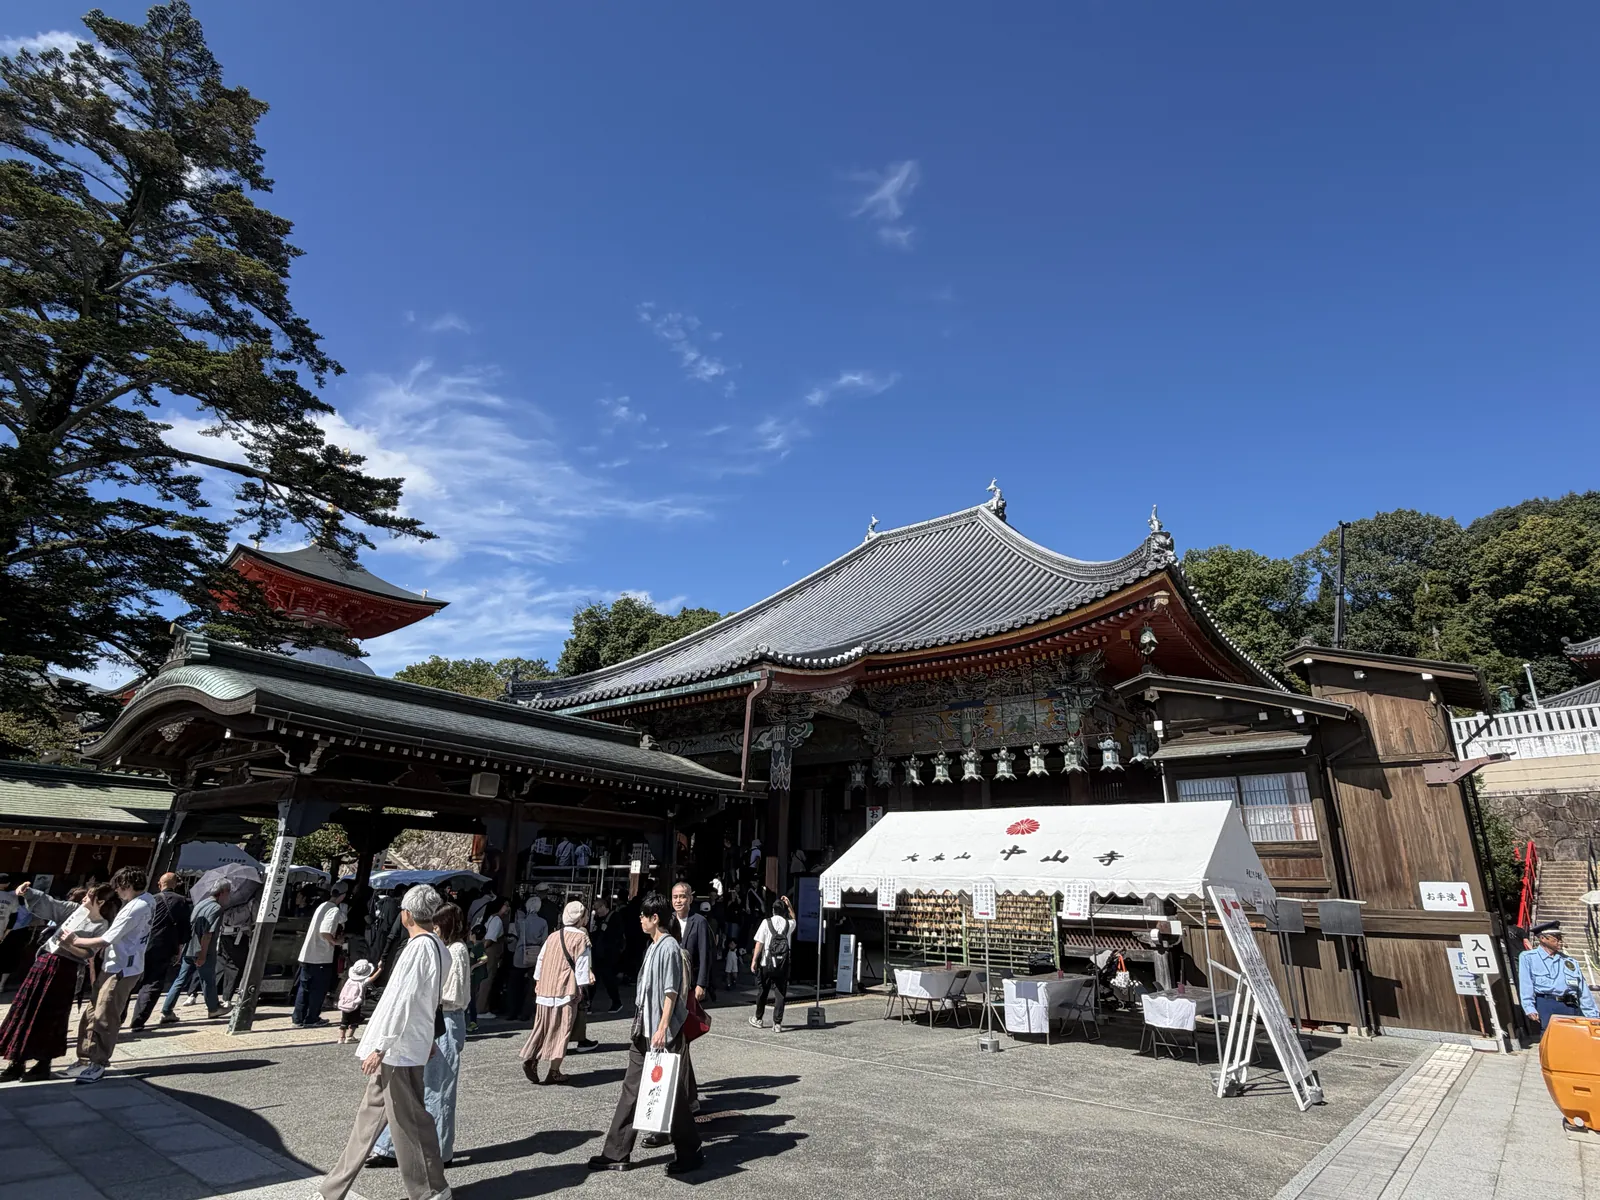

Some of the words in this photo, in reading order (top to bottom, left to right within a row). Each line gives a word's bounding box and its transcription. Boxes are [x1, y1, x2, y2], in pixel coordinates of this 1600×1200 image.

[1000, 845, 1125, 866] 中山寺
[1426, 892, 1457, 902] お手洗
[1471, 939, 1490, 968] 入口
